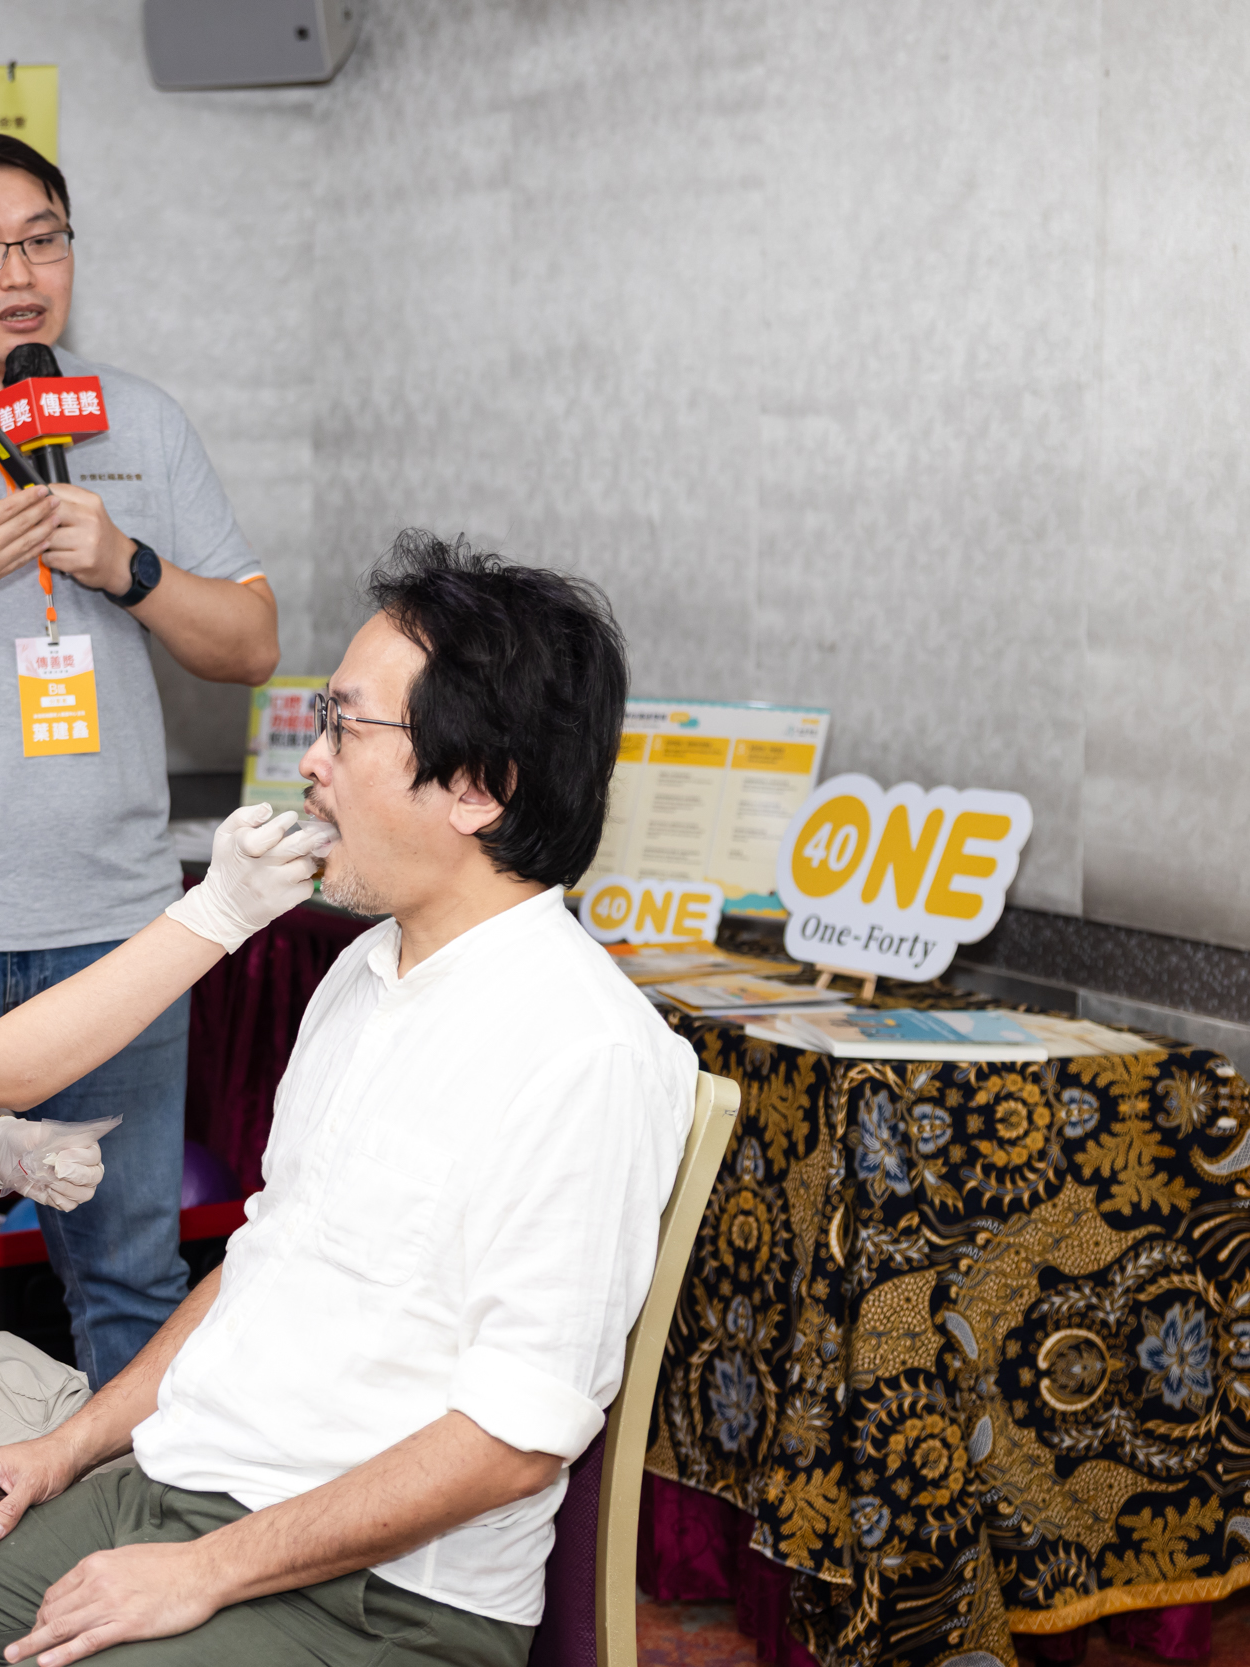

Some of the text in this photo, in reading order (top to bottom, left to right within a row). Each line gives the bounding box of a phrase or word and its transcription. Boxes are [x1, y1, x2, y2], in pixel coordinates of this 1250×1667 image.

[39, 390, 101, 417] 傳善獎
[36, 654, 75, 670] 傳善獎
[802, 822, 859, 873] 40
[595, 897, 627, 921] 40
[800, 913, 937, 969] One-Forty
